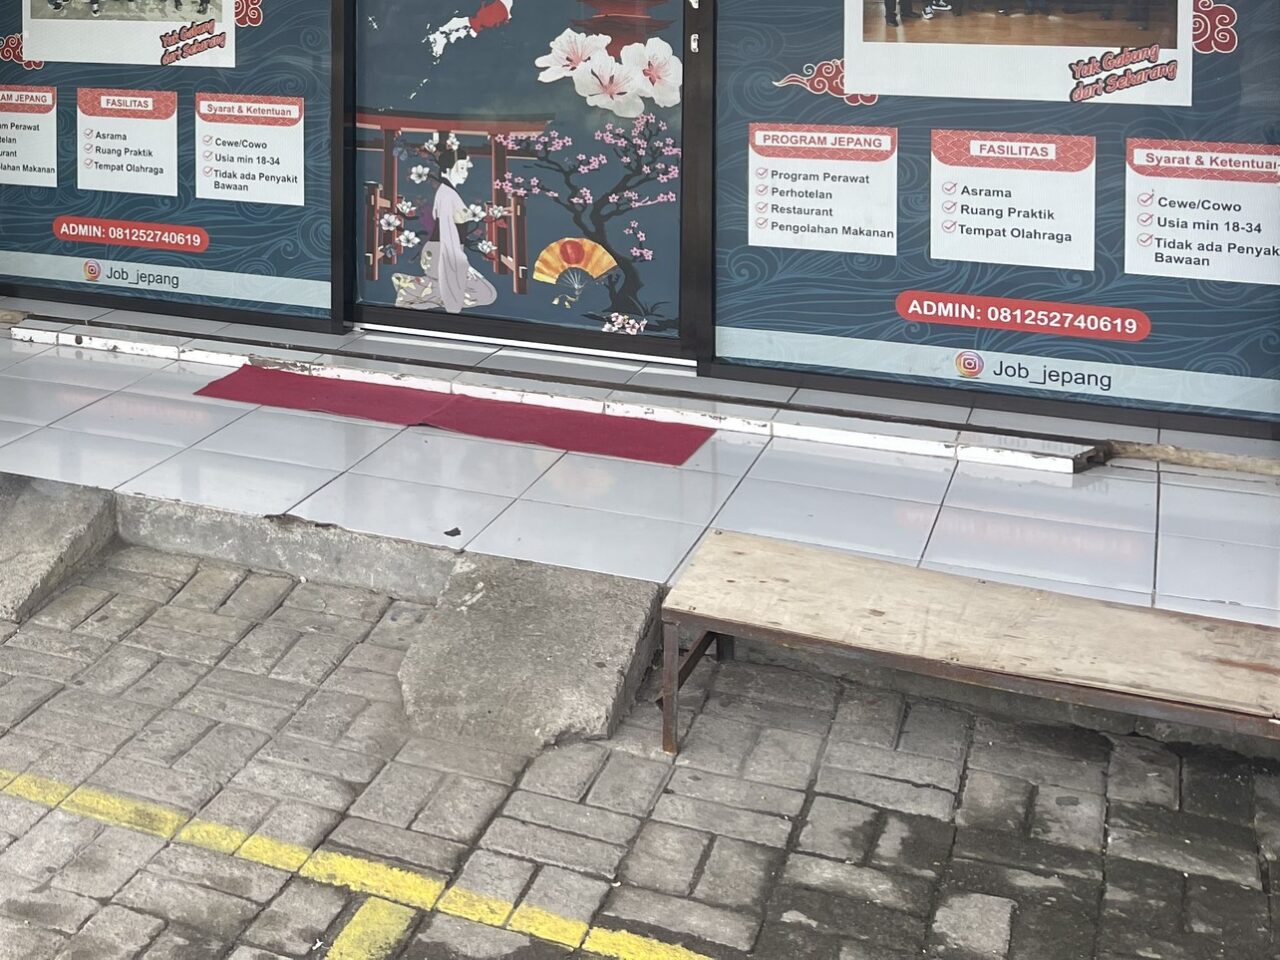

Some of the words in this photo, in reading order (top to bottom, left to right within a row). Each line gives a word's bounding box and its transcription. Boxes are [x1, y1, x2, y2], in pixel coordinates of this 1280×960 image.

[1069, 56, 1101, 80] Yuk
[1101, 43, 1160, 72] Gabung
[1069, 78, 1104, 102] dari
[1104, 60, 1177, 94] Sekarang
[15, 94, 48, 103] JEPANG
[105, 99, 149, 109] FASILITAS
[207, 103, 235, 115] Syarat
[236, 105, 244, 114] &
[246, 105, 292, 117] Ketentuan
[10, 122, 40, 131] Perawat
[95, 131, 127, 141] Asrama
[763, 134, 827, 146] PROGRAM
[830, 136, 882, 148] JEPANG
[215, 138, 267, 149] Cewe/Cowo
[979, 143, 1049, 157] FASILITAS
[95, 146, 122, 157] Ruang
[124, 147, 153, 158] Praktik
[1145, 152, 1190, 166] Syarat
[1195, 155, 1205, 166] &
[215, 153, 235, 163] Usia
[236, 155, 253, 164] min
[256, 155, 280, 166] 18-34
[22, 165, 55, 174] Makanan
[94, 161, 124, 172] Tempat
[125, 164, 164, 175] Olahraga
[213, 169, 238, 180] Tidak
[239, 171, 256, 181] ada
[258, 172, 298, 184] Penyakit
[771, 170, 819, 182] Program
[823, 172, 870, 184] Perawat
[214, 181, 249, 191] Bawaan
[771, 187, 833, 199] Perhotelan
[961, 185, 1012, 198] Asrama
[771, 204, 833, 217] Restaurant
[1158, 196, 1242, 212] Cewe/Cowo
[960, 204, 1004, 219] Ruang
[1007, 207, 1055, 220] Praktik
[771, 221, 838, 235] Pengolahan
[841, 226, 894, 238] Makanan
[1157, 216, 1188, 229] Usia
[1192, 220, 1219, 231] min
[1224, 221, 1262, 234] 18-34
[60, 222, 106, 238] ADMIN:
[108, 227, 201, 246] 081252740619
[958, 224, 1007, 238] Tempat
[1010, 227, 1072, 244] Olahraga
[1154, 237, 1193, 250] Tidak
[1197, 241, 1222, 253] ada
[1227, 242, 1280, 258] Penyak
[1154, 252, 1210, 266] Bawaan
[106, 267, 179, 288] Job_jepang
[908, 299, 982, 320] ADMIN:
[987, 306, 1137, 334] 081252740619
[993, 360, 1112, 391] Job_jepang
